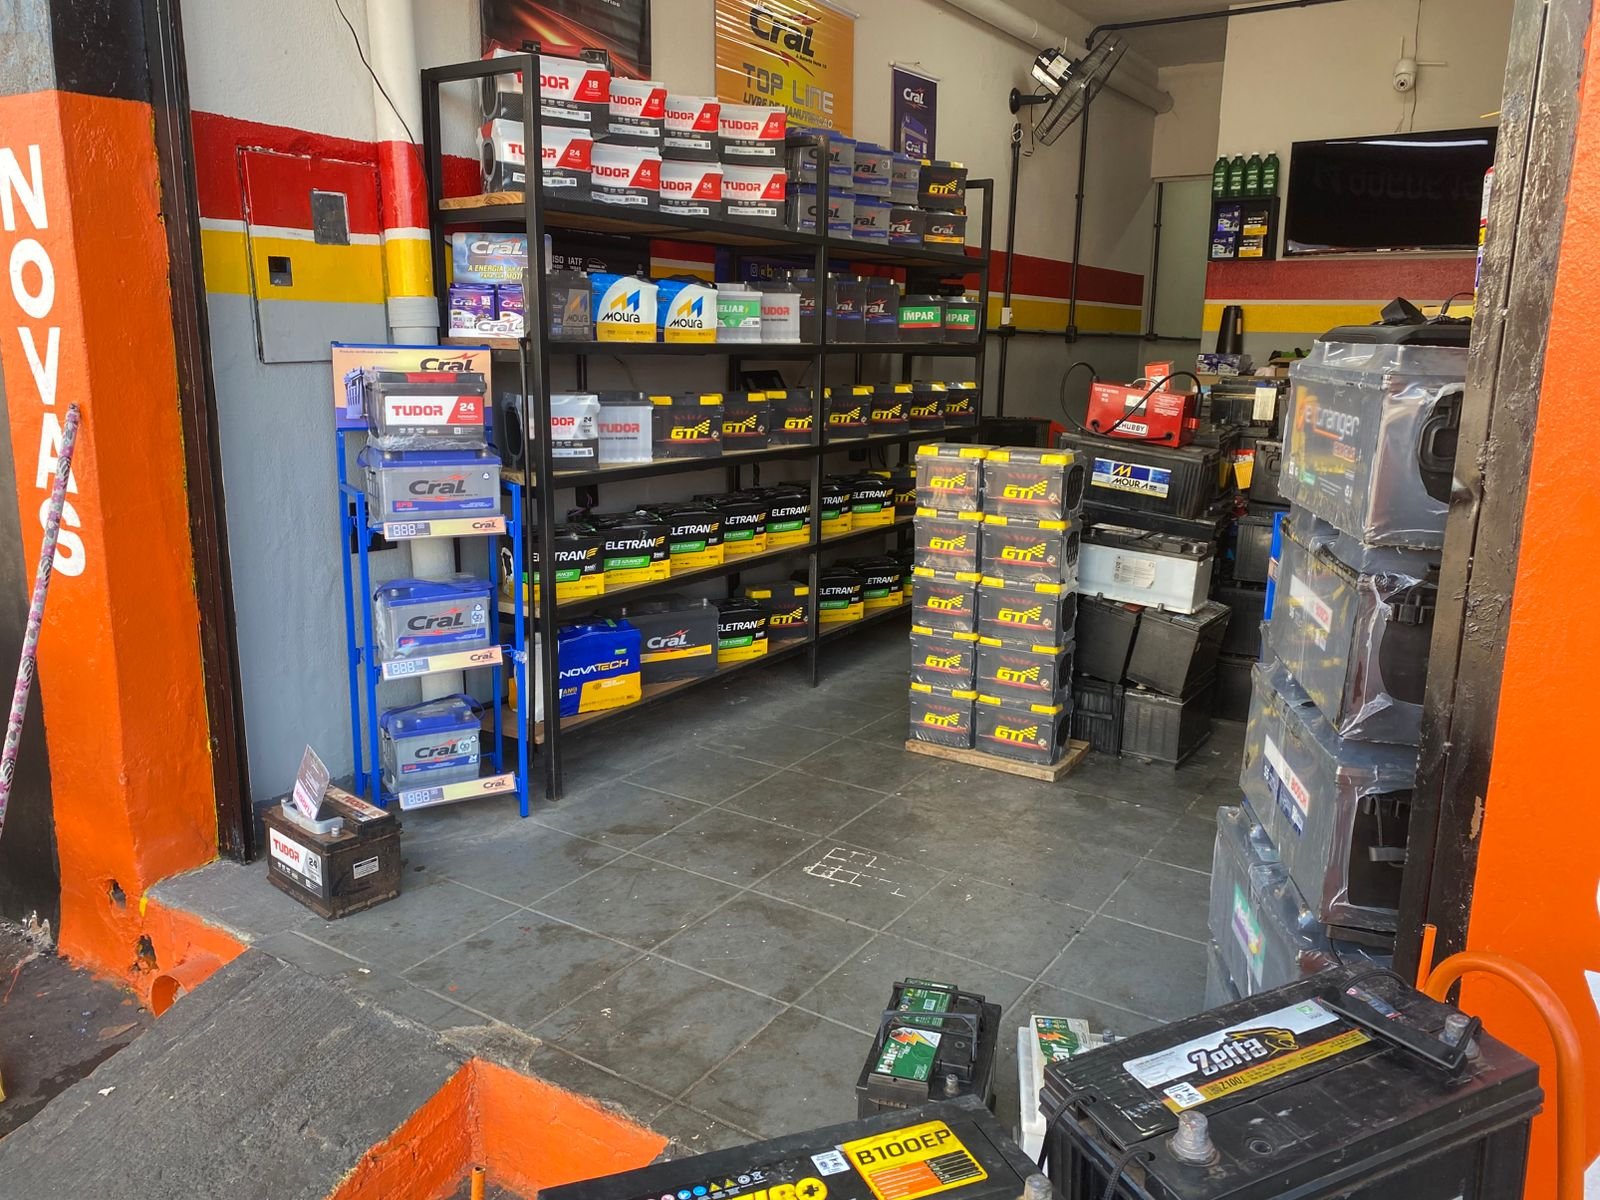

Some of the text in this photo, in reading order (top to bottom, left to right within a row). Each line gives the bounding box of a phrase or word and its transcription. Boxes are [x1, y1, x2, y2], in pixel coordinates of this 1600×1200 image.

[588, 79, 599, 89] 18
[742, 62, 784, 97] TOP
[719, 118, 759, 131] TUDOR
[569, 148, 581, 158] 24
[640, 168, 651, 177] 24
[702, 182, 712, 190] 24
[723, 180, 761, 192] TUDOR
[770, 182, 780, 190] 24
[552, 255, 583, 265] ISO IATF
[903, 310, 934, 321] IMPAR
[0, 143, 87, 577] NOVAS
[392, 405, 443, 417] TUDOR
[460, 402, 475, 412] 24
[598, 423, 640, 433] TUDOR
[1003, 484, 1034, 500] GTI
[771, 505, 807, 517] ELETRAN
[605, 538, 656, 550] ELETRAN
[1001, 546, 1032, 561] GTI
[998, 608, 1028, 624] GTI
[559, 658, 629, 680] NOVATECH
[996, 667, 1026, 683] GTI
[994, 726, 1024, 743] GTI
[273, 837, 300, 863] TUDOR
[308, 857, 318, 869] 24
[1191, 1038, 1269, 1077] Zetta
[856, 1128, 952, 1166] B100EP
